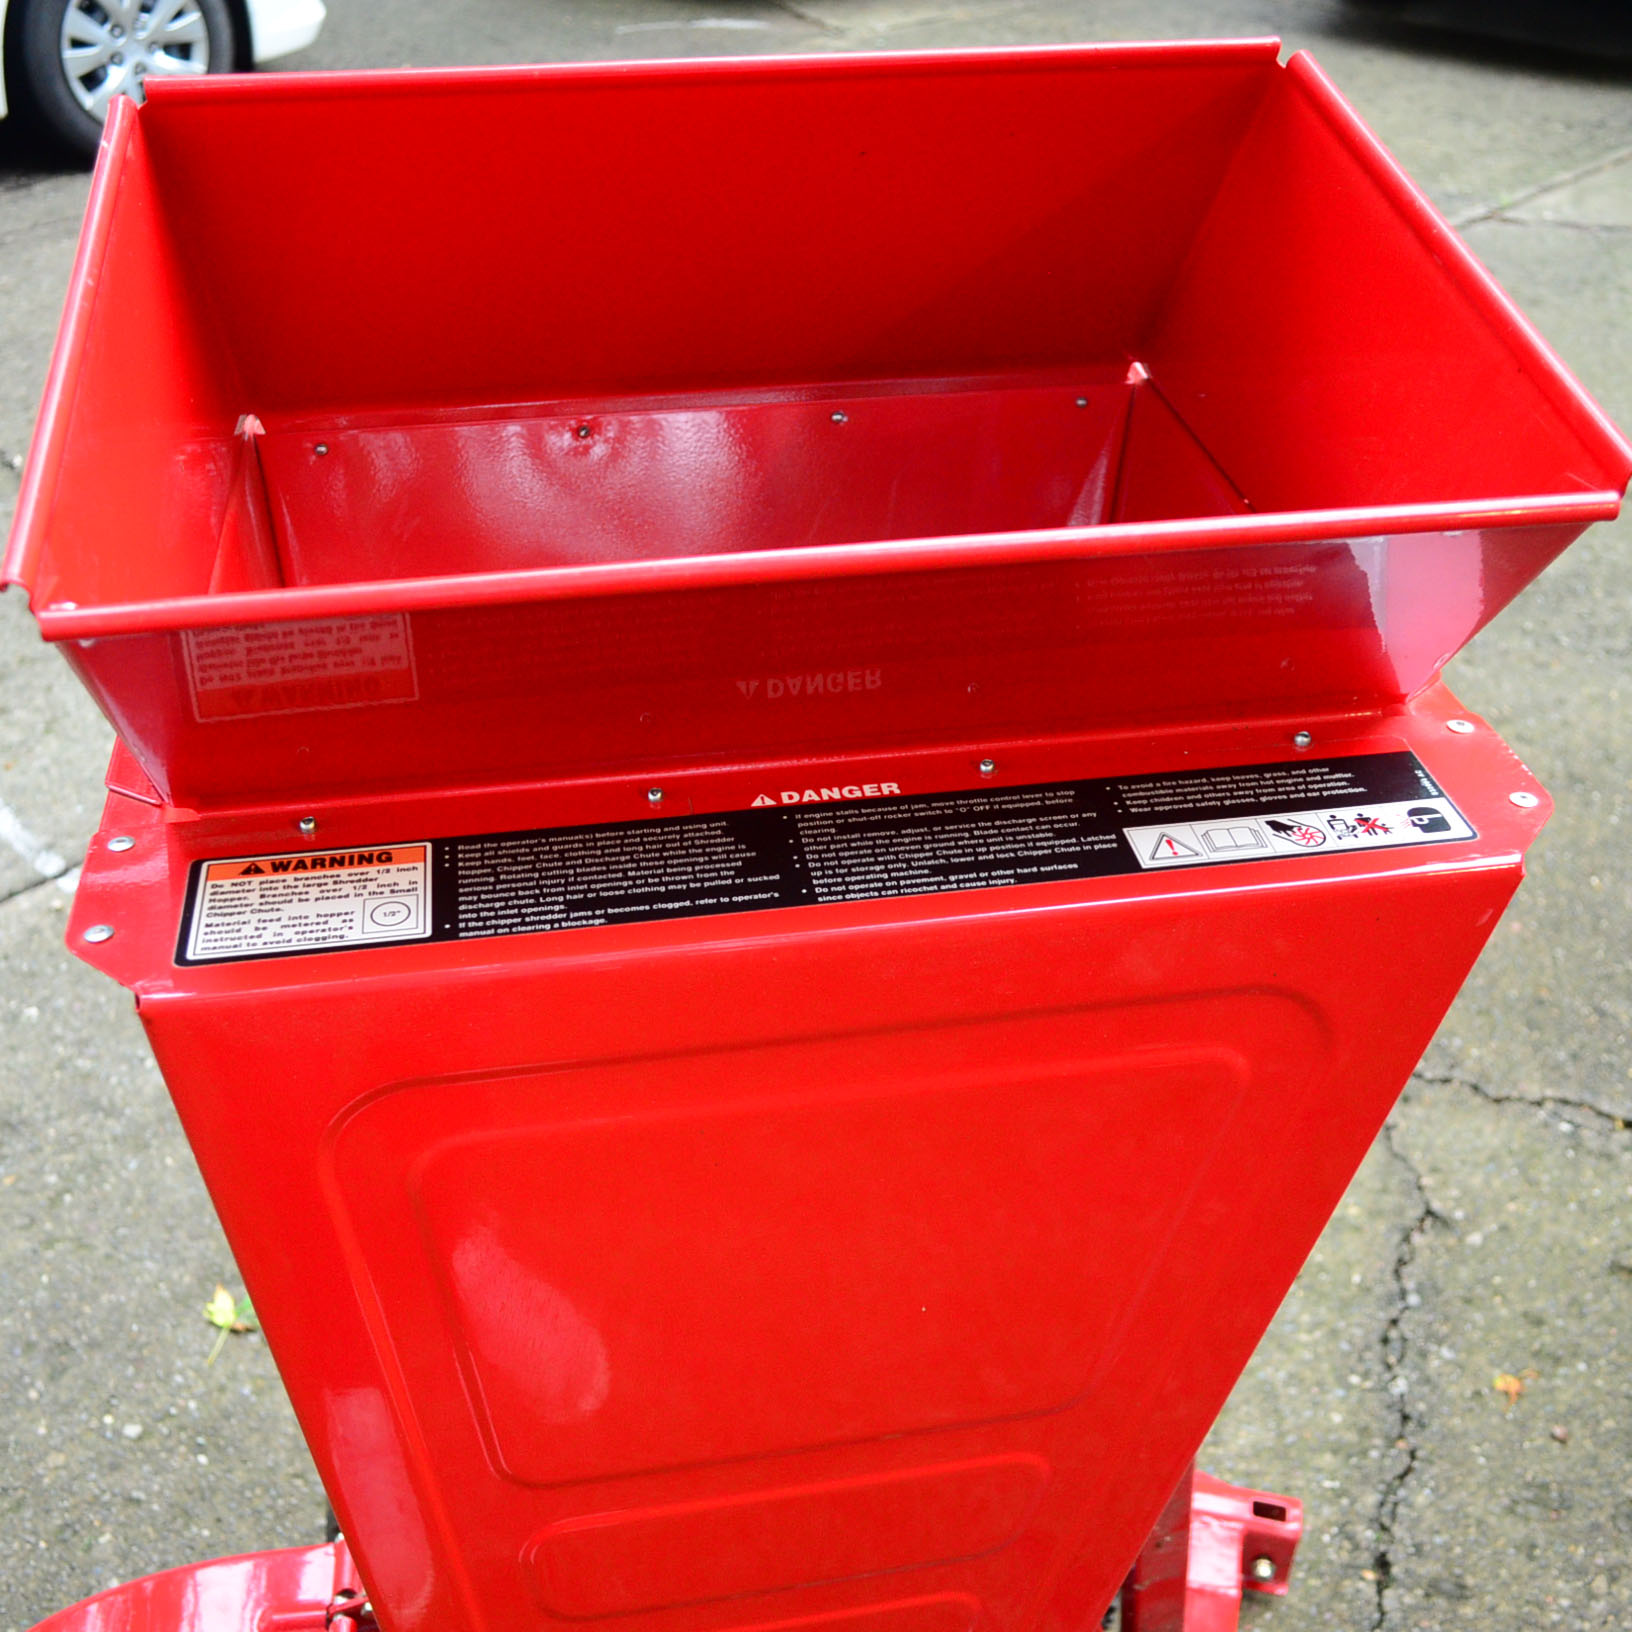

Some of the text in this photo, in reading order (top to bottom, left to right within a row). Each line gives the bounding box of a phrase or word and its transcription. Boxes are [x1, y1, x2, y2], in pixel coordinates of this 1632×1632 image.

[780, 782, 901, 804] DANGER
[840, 856, 874, 867] operate
[877, 854, 896, 862] with
[898, 852, 932, 861] Chipper
[936, 848, 962, 856] Chute
[989, 843, 1025, 854] position
[1080, 834, 1116, 843] Latched
[851, 864, 884, 872] storage
[996, 851, 1014, 859] lock
[1017, 849, 1051, 858] Chipper
[1054, 845, 1080, 854] Chute
[1093, 843, 1117, 852] place
[270, 851, 393, 873] WARNING
[210, 886, 255, 896] diameter
[259, 883, 278, 891] into
[302, 880, 328, 888] large
[332, 875, 377, 885] Shredder
[230, 878, 252, 887] NOT
[258, 877, 286, 887] place
[293, 872, 340, 882] branches
[376, 866, 390, 875] 1/2
[396, 864, 418, 873] inch
[458, 885, 492, 893] serious
[495, 879, 536, 891] personal
[539, 878, 564, 887] injury
[627, 868, 663, 877] Material
[666, 866, 692, 874] being
[694, 860, 742, 873] processed
[844, 872, 888, 883] operating
[848, 881, 882, 892] operate
[948, 872, 976, 883] gravel
[1016, 866, 1037, 874] hard
[1039, 864, 1077, 872] surfaces
[259, 888, 309, 898] Branches
[352, 882, 367, 890] 1/2
[376, 879, 399, 888] inch
[458, 901, 505, 911] discharge
[627, 886, 665, 895] clothing
[703, 878, 732, 889] pulled
[747, 874, 779, 883] sucked
[480, 891, 515, 899] bounce
[517, 887, 540, 896] back
[567, 883, 587, 891] inlet
[590, 880, 632, 890] openings
[661, 874, 693, 882] thrown
[845, 890, 878, 900] objects
[900, 884, 937, 894] ricochet
[940, 882, 956, 890] and
[207, 900, 253, 910] diameter
[258, 896, 293, 906] should
[314, 891, 349, 903] placed
[389, 885, 417, 894] Small
[205, 910, 354, 928] Material feed into hopper
[206, 909, 246, 919] Chipper
[486, 917, 521, 926] chipper
[524, 912, 566, 922] shredder
[569, 910, 592, 920] jams
[607, 905, 650, 914] becomes
[497, 908, 518, 916] inlet
[202, 931, 262, 943] instructed
[203, 925, 241, 936] should
[280, 918, 328, 929] metered
[459, 928, 494, 937] manual
[511, 923, 550, 932] clearing
[201, 940, 242, 951] manual
[262, 936, 292, 946] avoid
